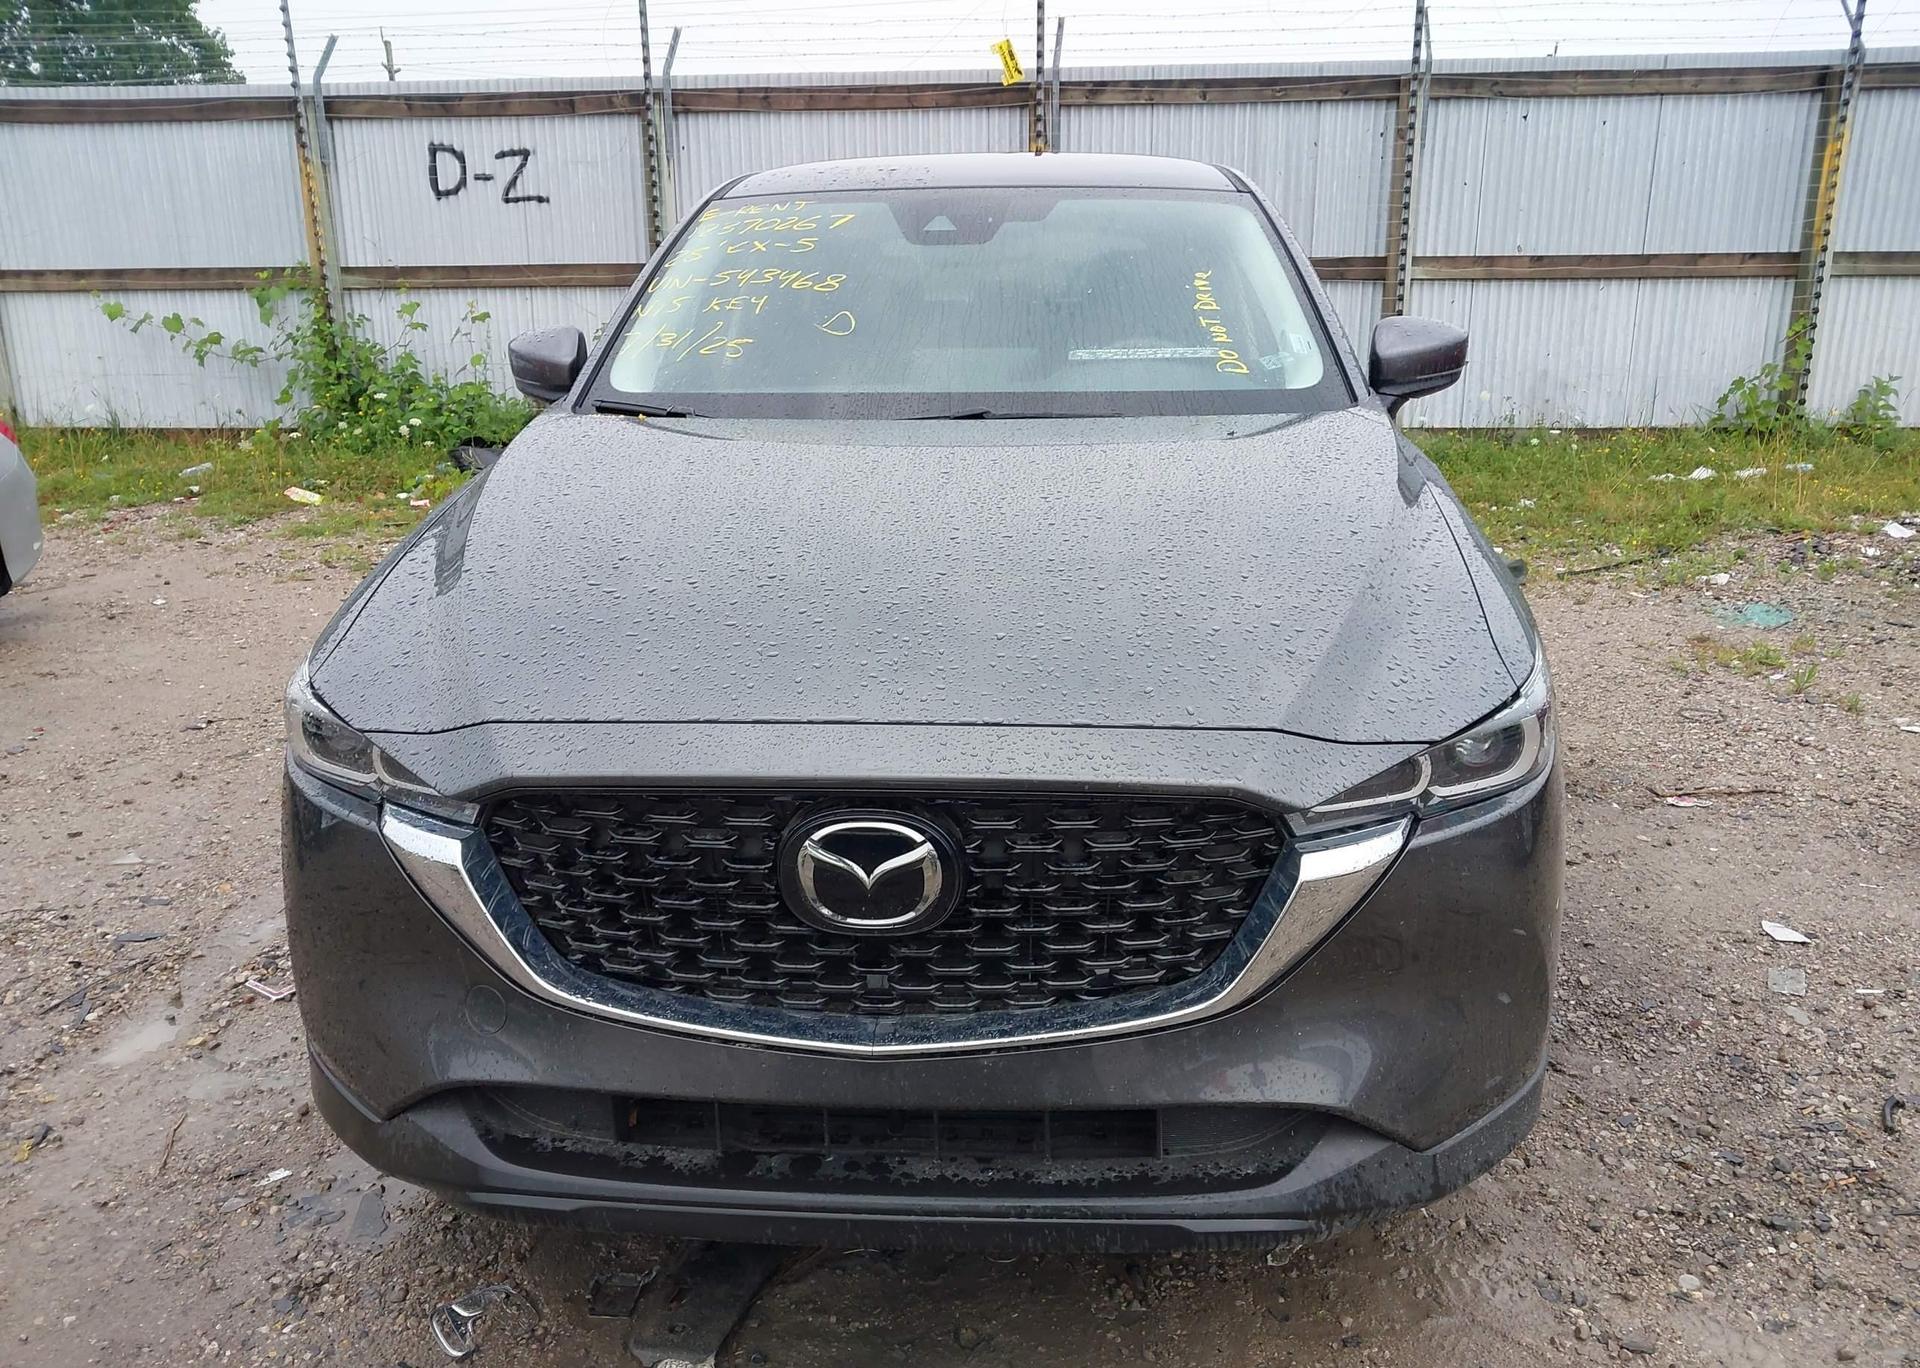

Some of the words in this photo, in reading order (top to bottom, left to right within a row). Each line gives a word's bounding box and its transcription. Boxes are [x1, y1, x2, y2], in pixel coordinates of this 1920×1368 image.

[702, 295, 769, 315] KEY
[1199, 316, 1233, 343] NOT
[1216, 349, 1250, 375] DO
